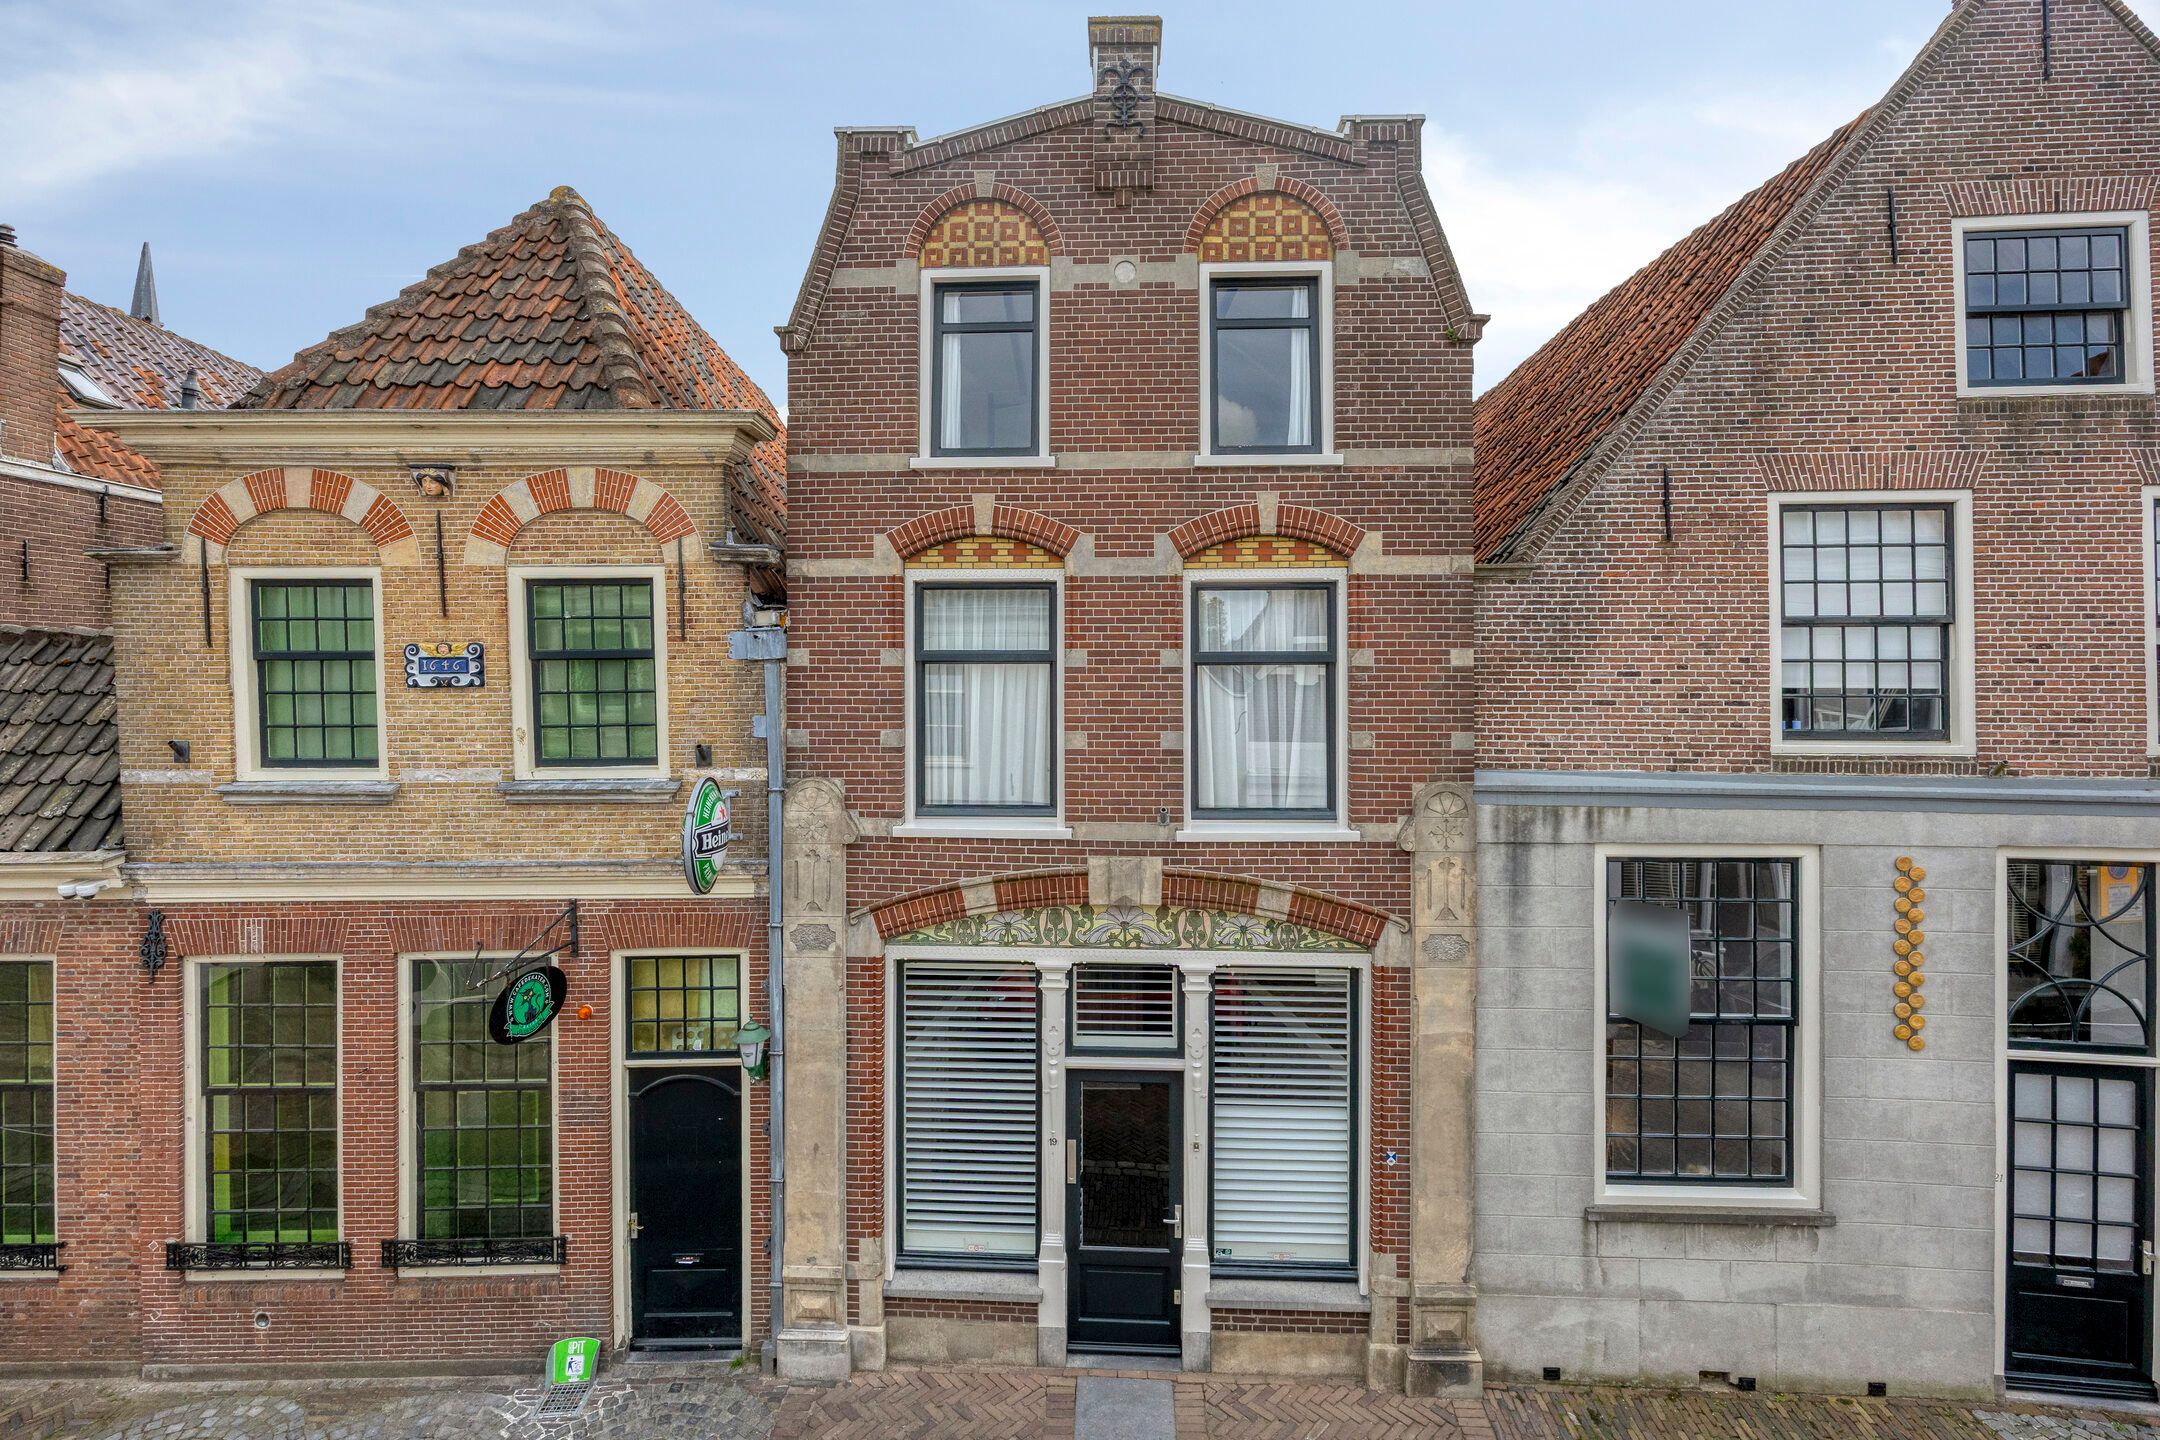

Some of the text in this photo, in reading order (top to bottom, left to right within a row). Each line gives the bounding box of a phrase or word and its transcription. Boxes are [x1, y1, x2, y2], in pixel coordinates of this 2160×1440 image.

[422, 659, 466, 671] 1646
[1049, 1137, 1058, 1146] 19
[1994, 1173, 2004, 1183] 21
